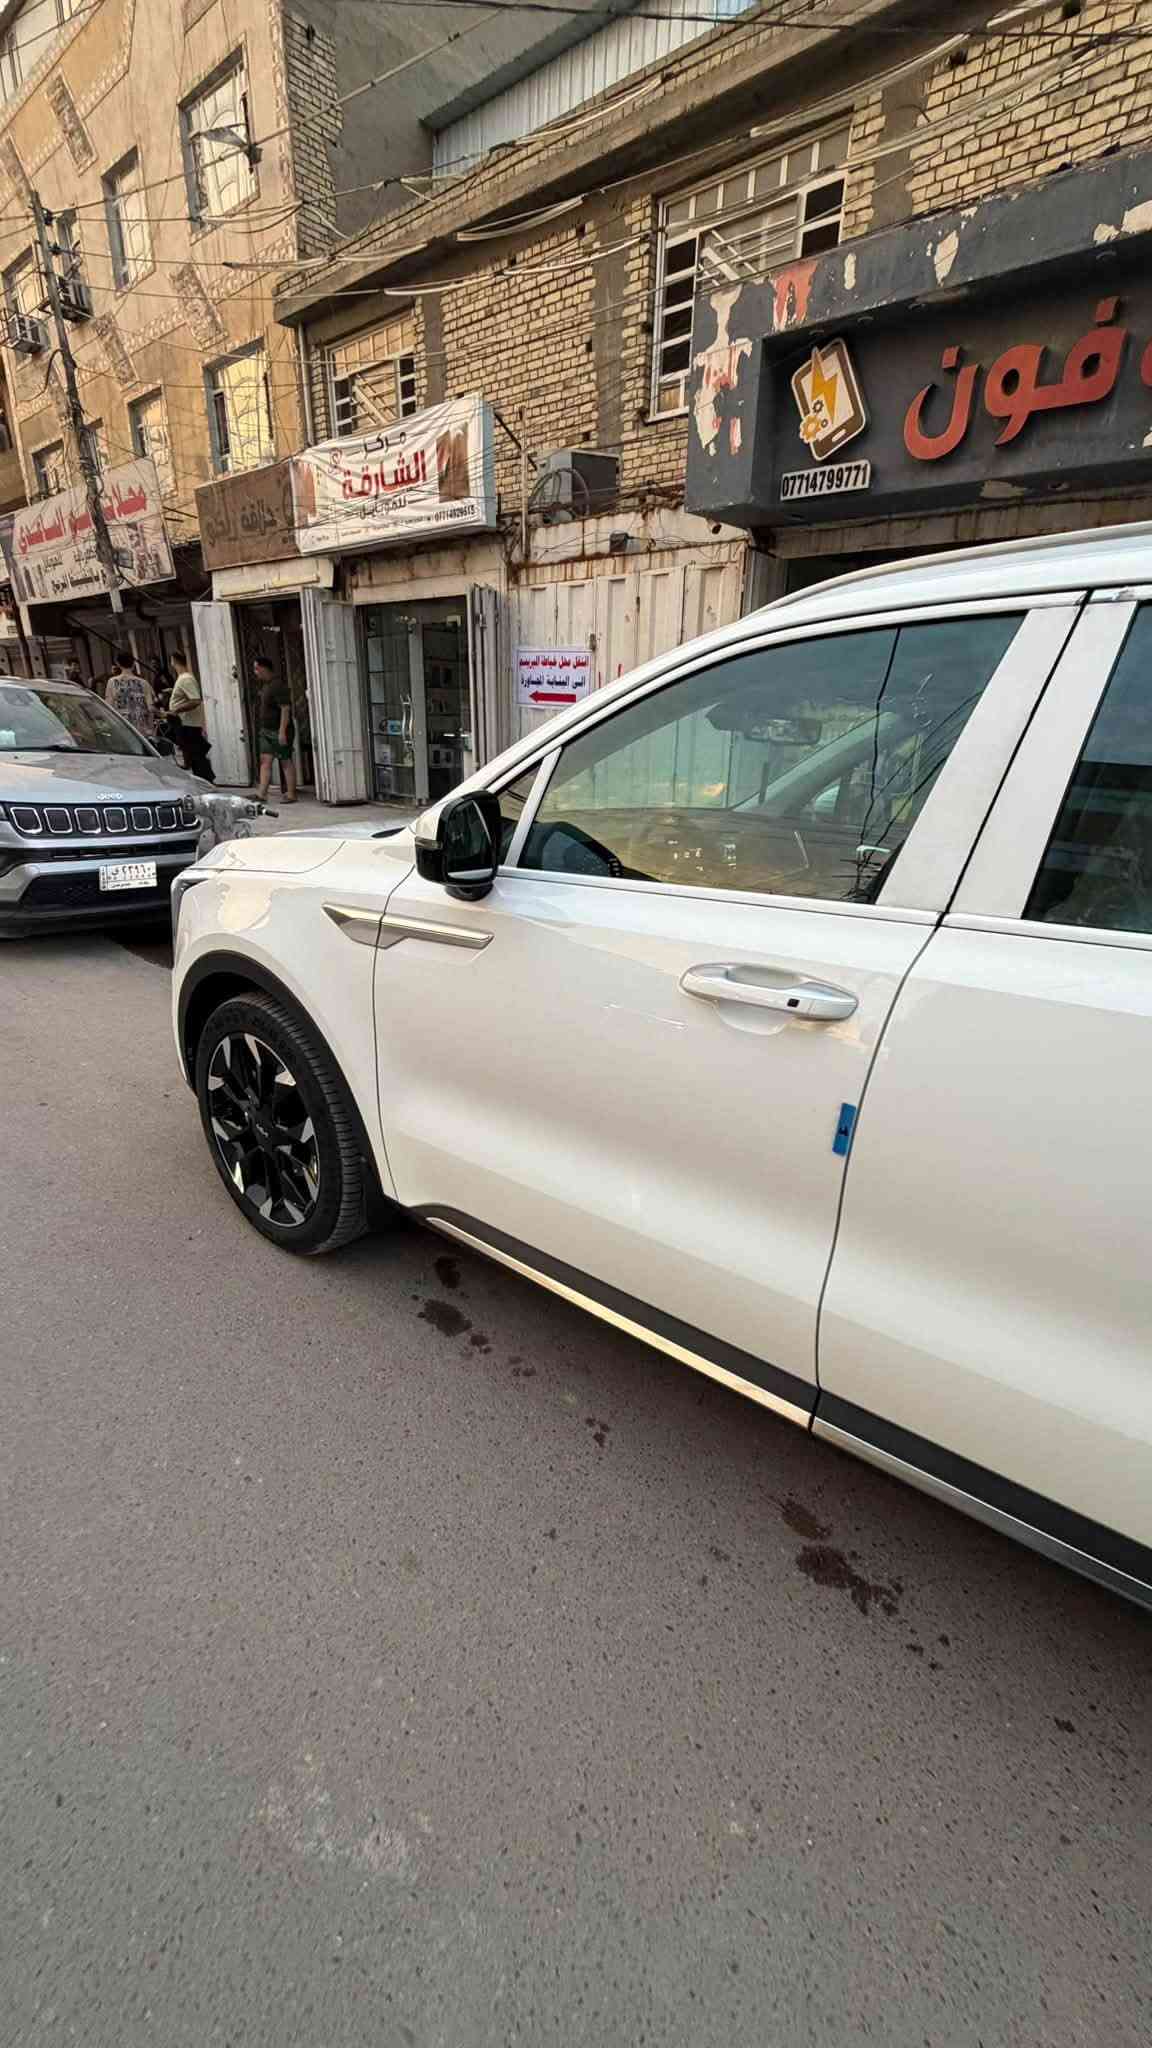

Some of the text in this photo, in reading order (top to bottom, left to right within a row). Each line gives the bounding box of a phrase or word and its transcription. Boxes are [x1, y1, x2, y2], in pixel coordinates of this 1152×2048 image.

[363, 431, 407, 461] مركز
[342, 450, 427, 501] الشارقة
[782, 465, 867, 497] 07714799771
